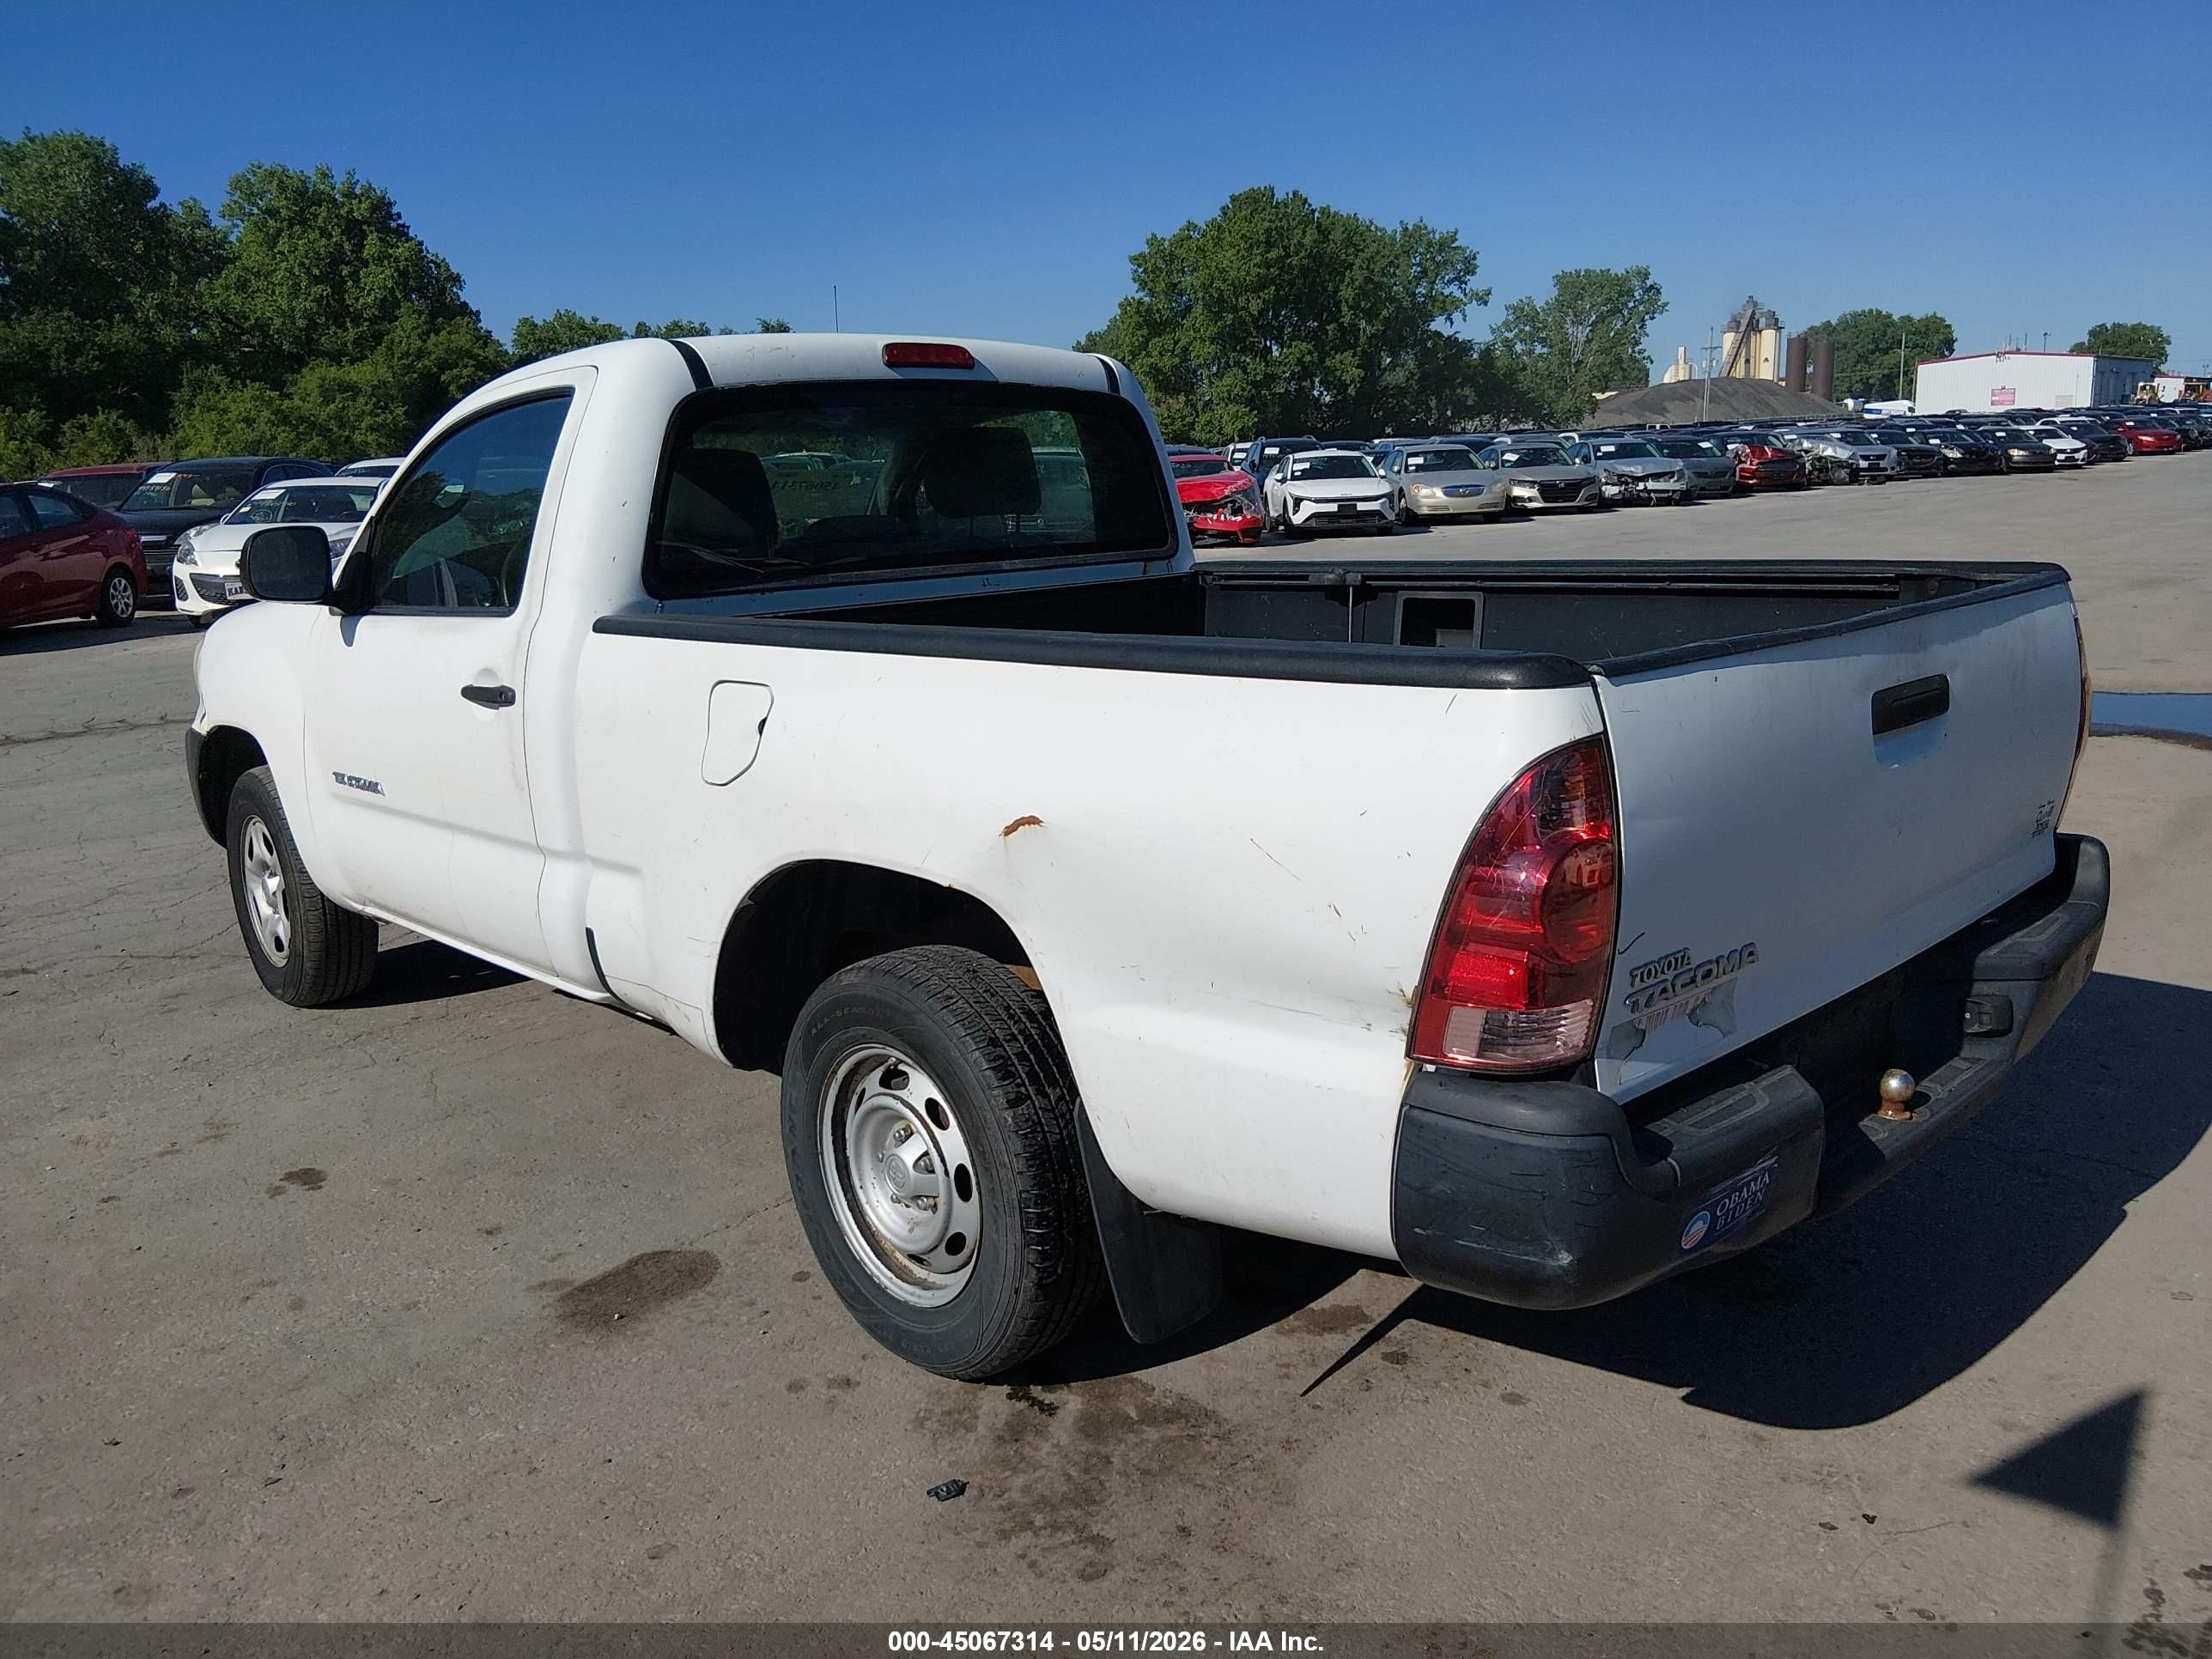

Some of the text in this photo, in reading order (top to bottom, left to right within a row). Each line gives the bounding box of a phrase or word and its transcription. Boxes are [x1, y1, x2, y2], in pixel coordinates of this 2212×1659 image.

[1623, 942, 1759, 1013] TACOMA
[1630, 947, 1692, 988] TOYOTA
[1716, 1170, 1770, 1216] OBAMA
[1716, 1187, 1765, 1230] BIDEN
